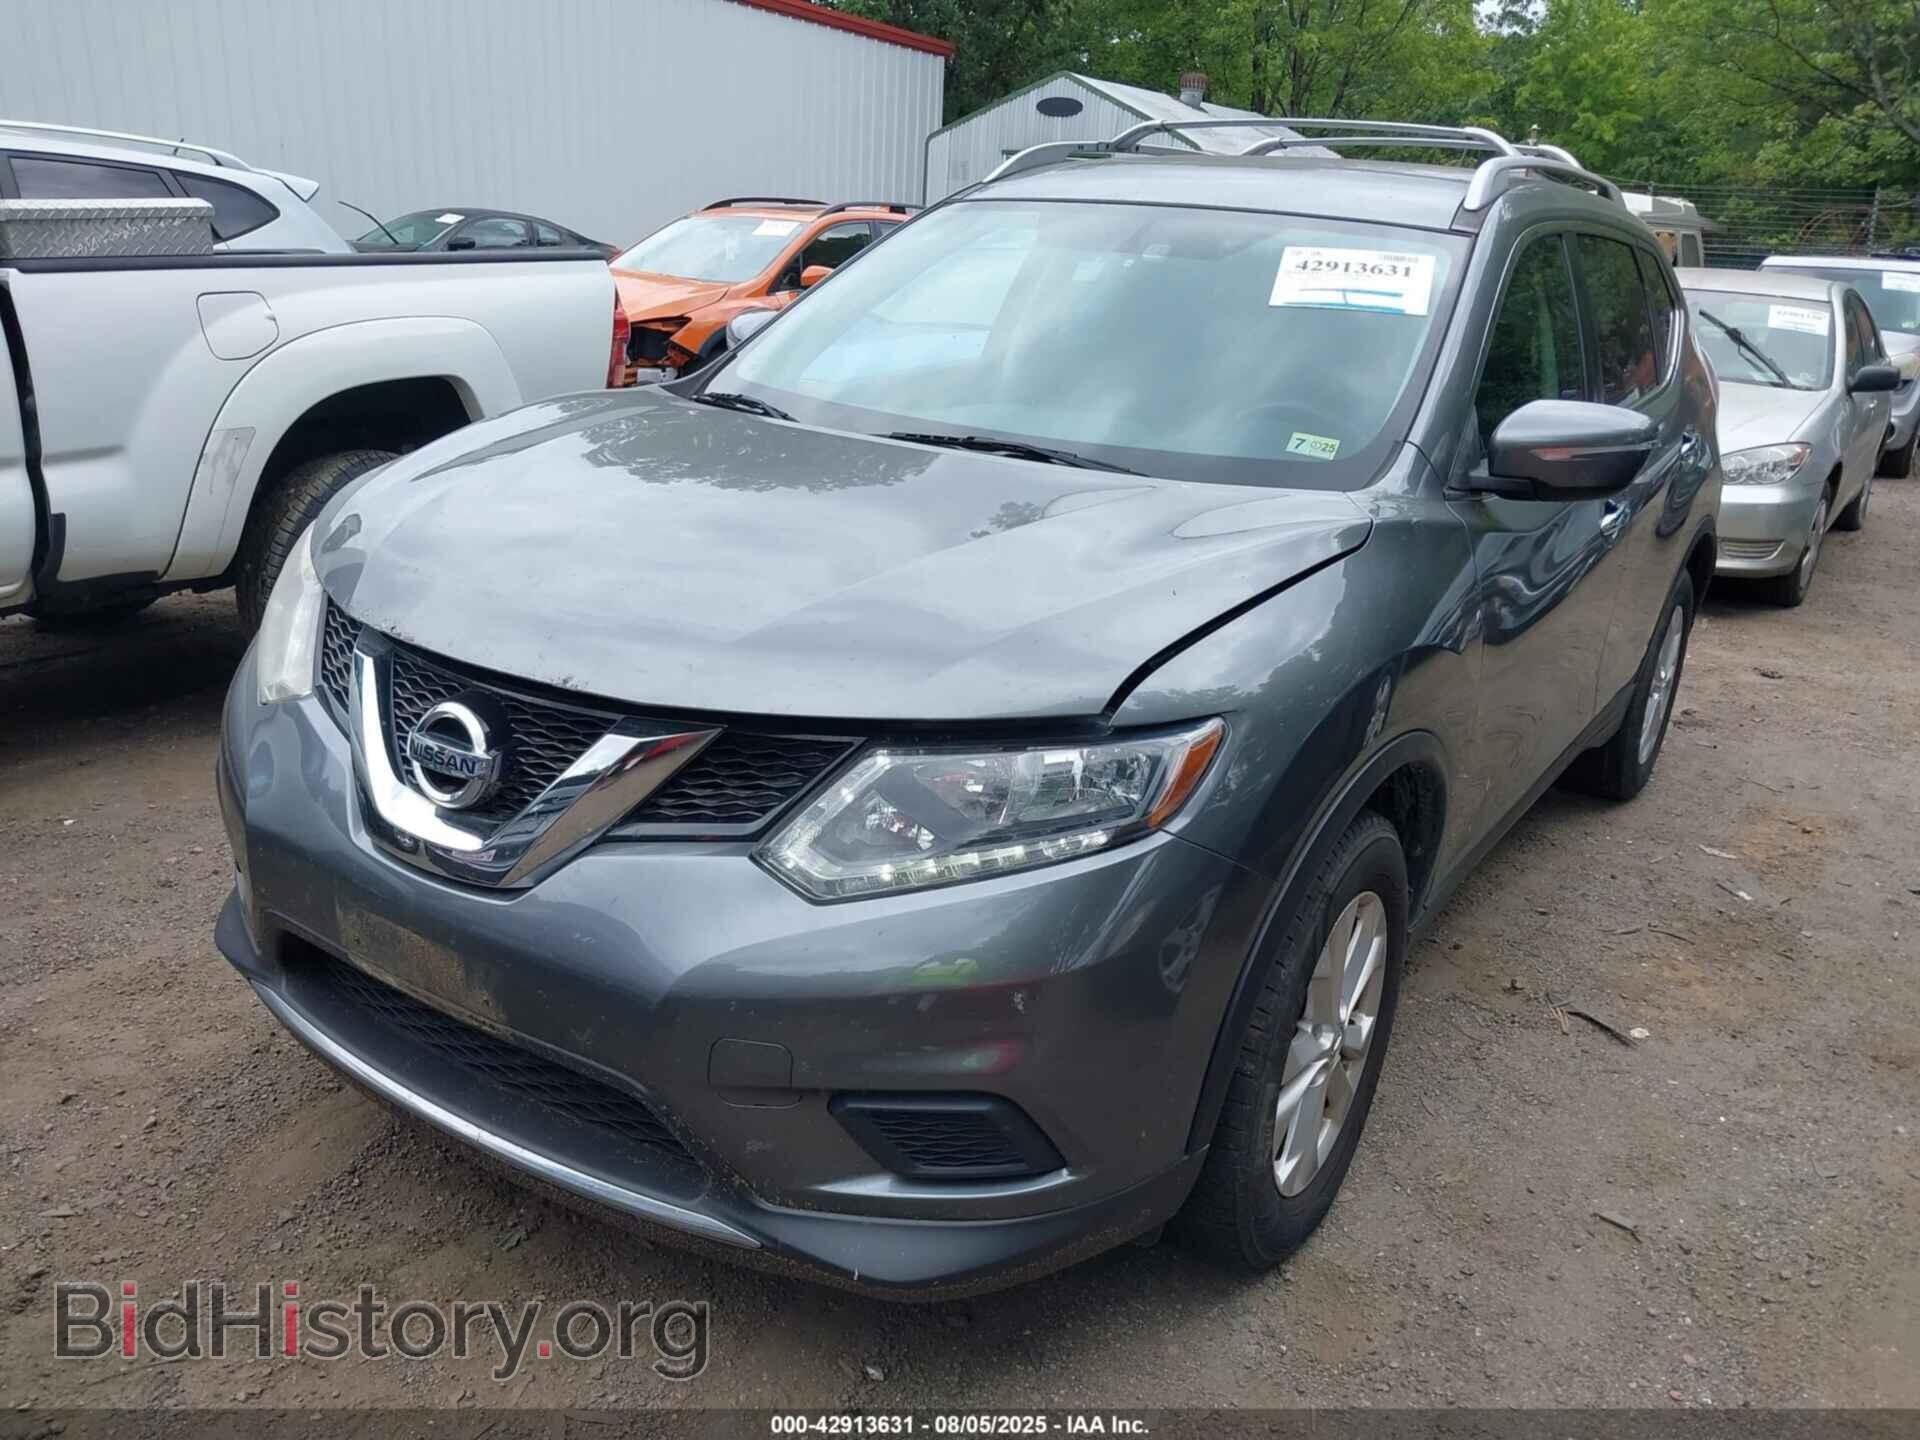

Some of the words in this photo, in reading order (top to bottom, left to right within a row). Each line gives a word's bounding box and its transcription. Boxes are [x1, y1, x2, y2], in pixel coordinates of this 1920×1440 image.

[1295, 259, 1412, 278] 42913631
[1294, 437, 1306, 449] 7
[409, 741, 477, 775] NISSAN
